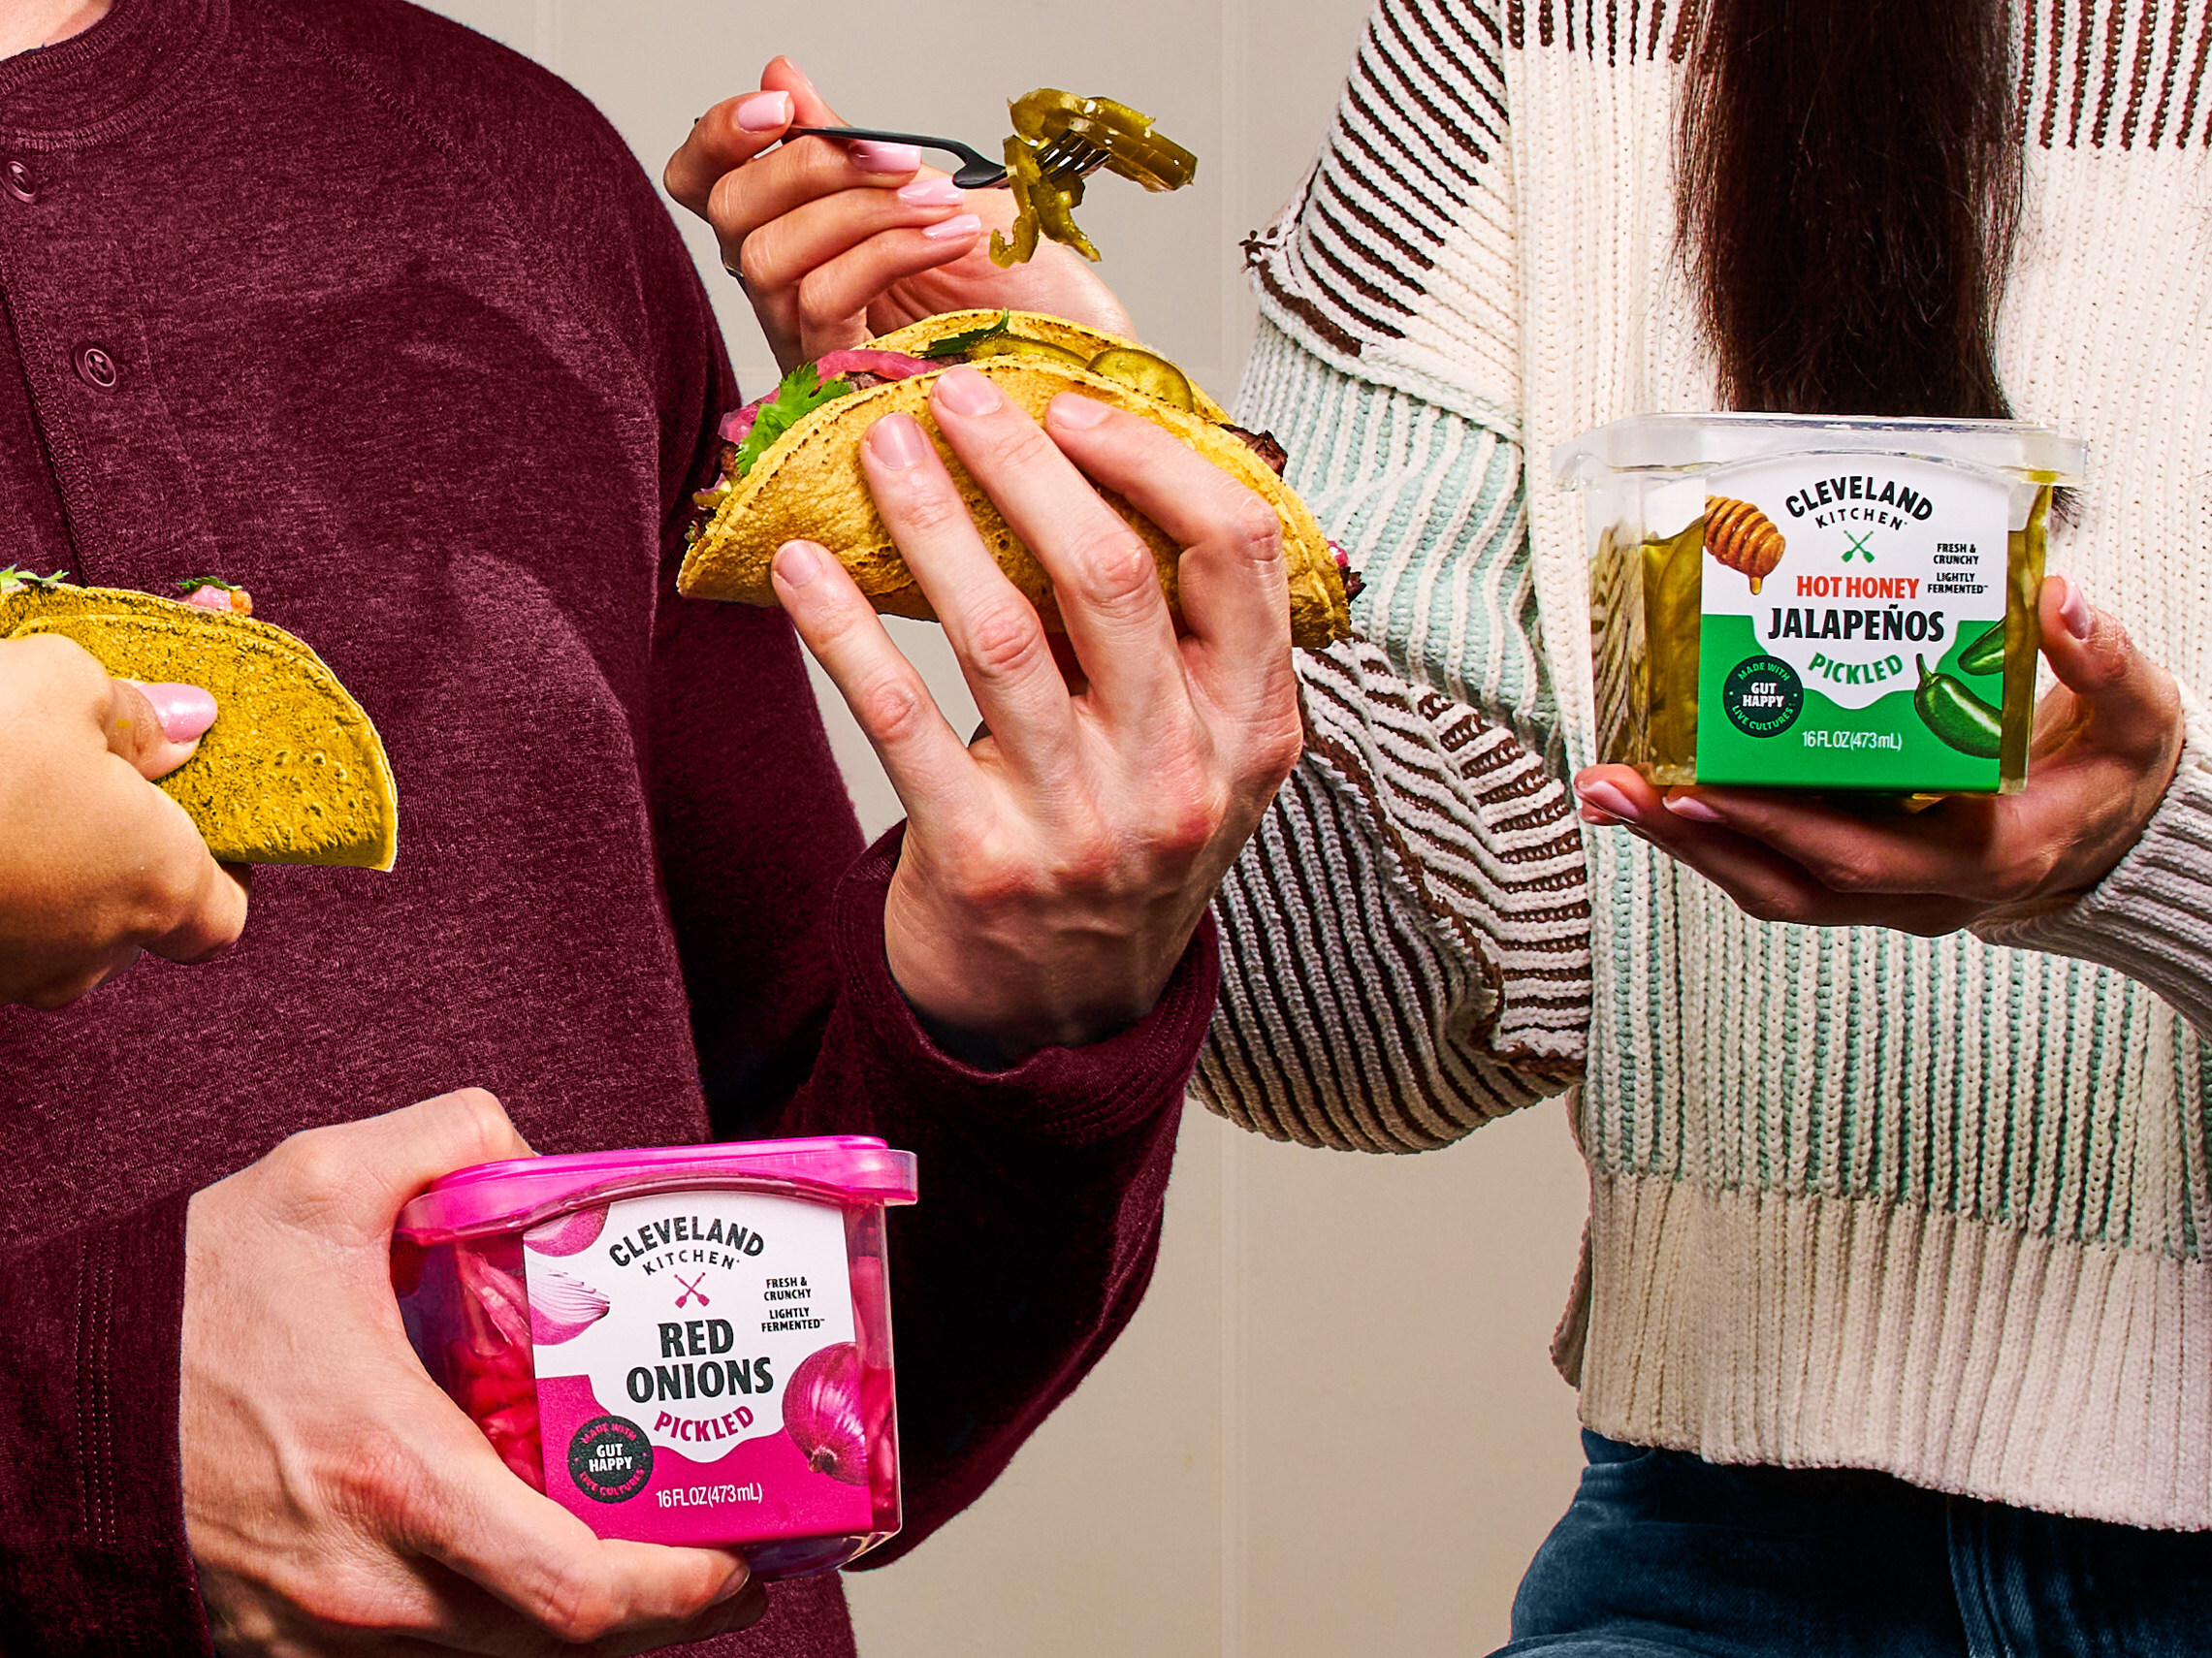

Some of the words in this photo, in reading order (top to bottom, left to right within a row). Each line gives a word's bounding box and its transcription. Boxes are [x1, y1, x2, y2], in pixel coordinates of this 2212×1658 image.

[1785, 476, 1933, 520] CLEVELAND
[1815, 508, 1903, 530] KITCHEN
[1937, 543, 1967, 553] FRESH
[1970, 544, 1976, 553] &
[1934, 555, 1979, 564] CRUNCHY
[1937, 572, 1974, 582] LIGHTLY
[1797, 576, 1842, 597] HOT
[1846, 577, 1920, 599] HONEY
[1768, 604, 1944, 642] JALAPEÑOS
[1738, 662, 1765, 680] MADE
[1767, 662, 1790, 681] WITH
[1808, 653, 1904, 685] PICKLED
[1750, 683, 1778, 694] GUT
[1743, 695, 1784, 708] HAPPY
[1732, 705, 1749, 725] LIVE
[609, 1216, 764, 1267] CLEVELAND
[642, 1249, 734, 1276] KITCHEN
[766, 1277, 797, 1289] FRESH
[800, 1276, 807, 1287] &
[764, 1289, 811, 1301] CRUNCHY
[769, 1307, 810, 1320] LIGHTLY
[657, 1319, 734, 1358] RED
[626, 1356, 774, 1404] ONIONS
[654, 1406, 754, 1442] PICKLED
[596, 1444, 624, 1457] GUT
[589, 1456, 633, 1472] HAPPY
